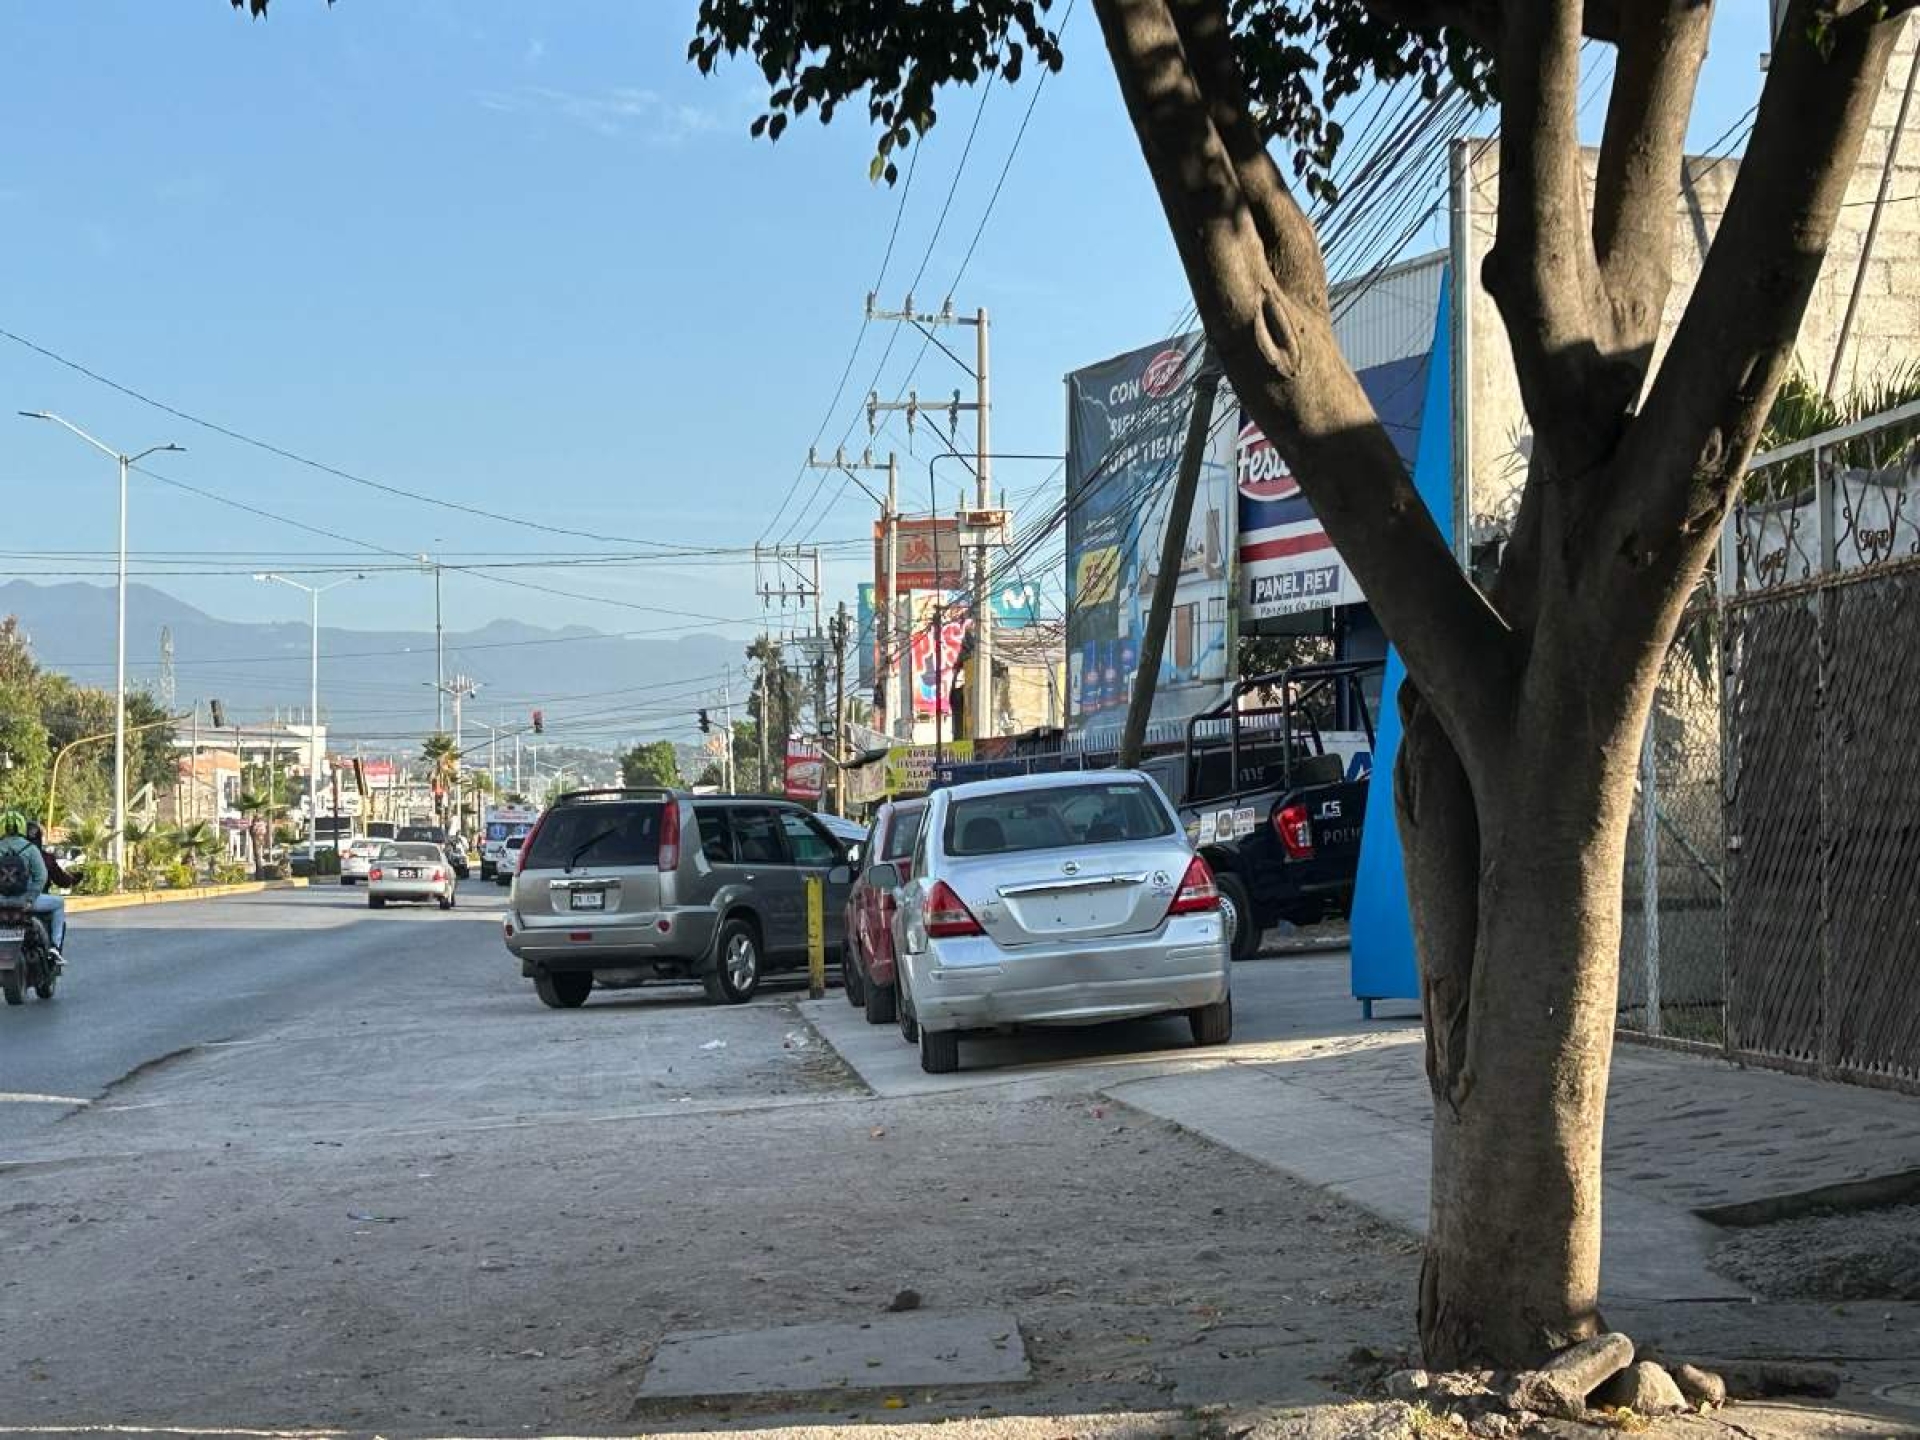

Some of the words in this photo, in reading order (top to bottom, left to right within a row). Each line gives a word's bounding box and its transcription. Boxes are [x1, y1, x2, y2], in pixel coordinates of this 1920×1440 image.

[1109, 379, 1140, 406] CON
[1141, 431, 1188, 464] TIEMP
[1256, 574, 1300, 600] PANEL
[1304, 569, 1334, 592] REY
